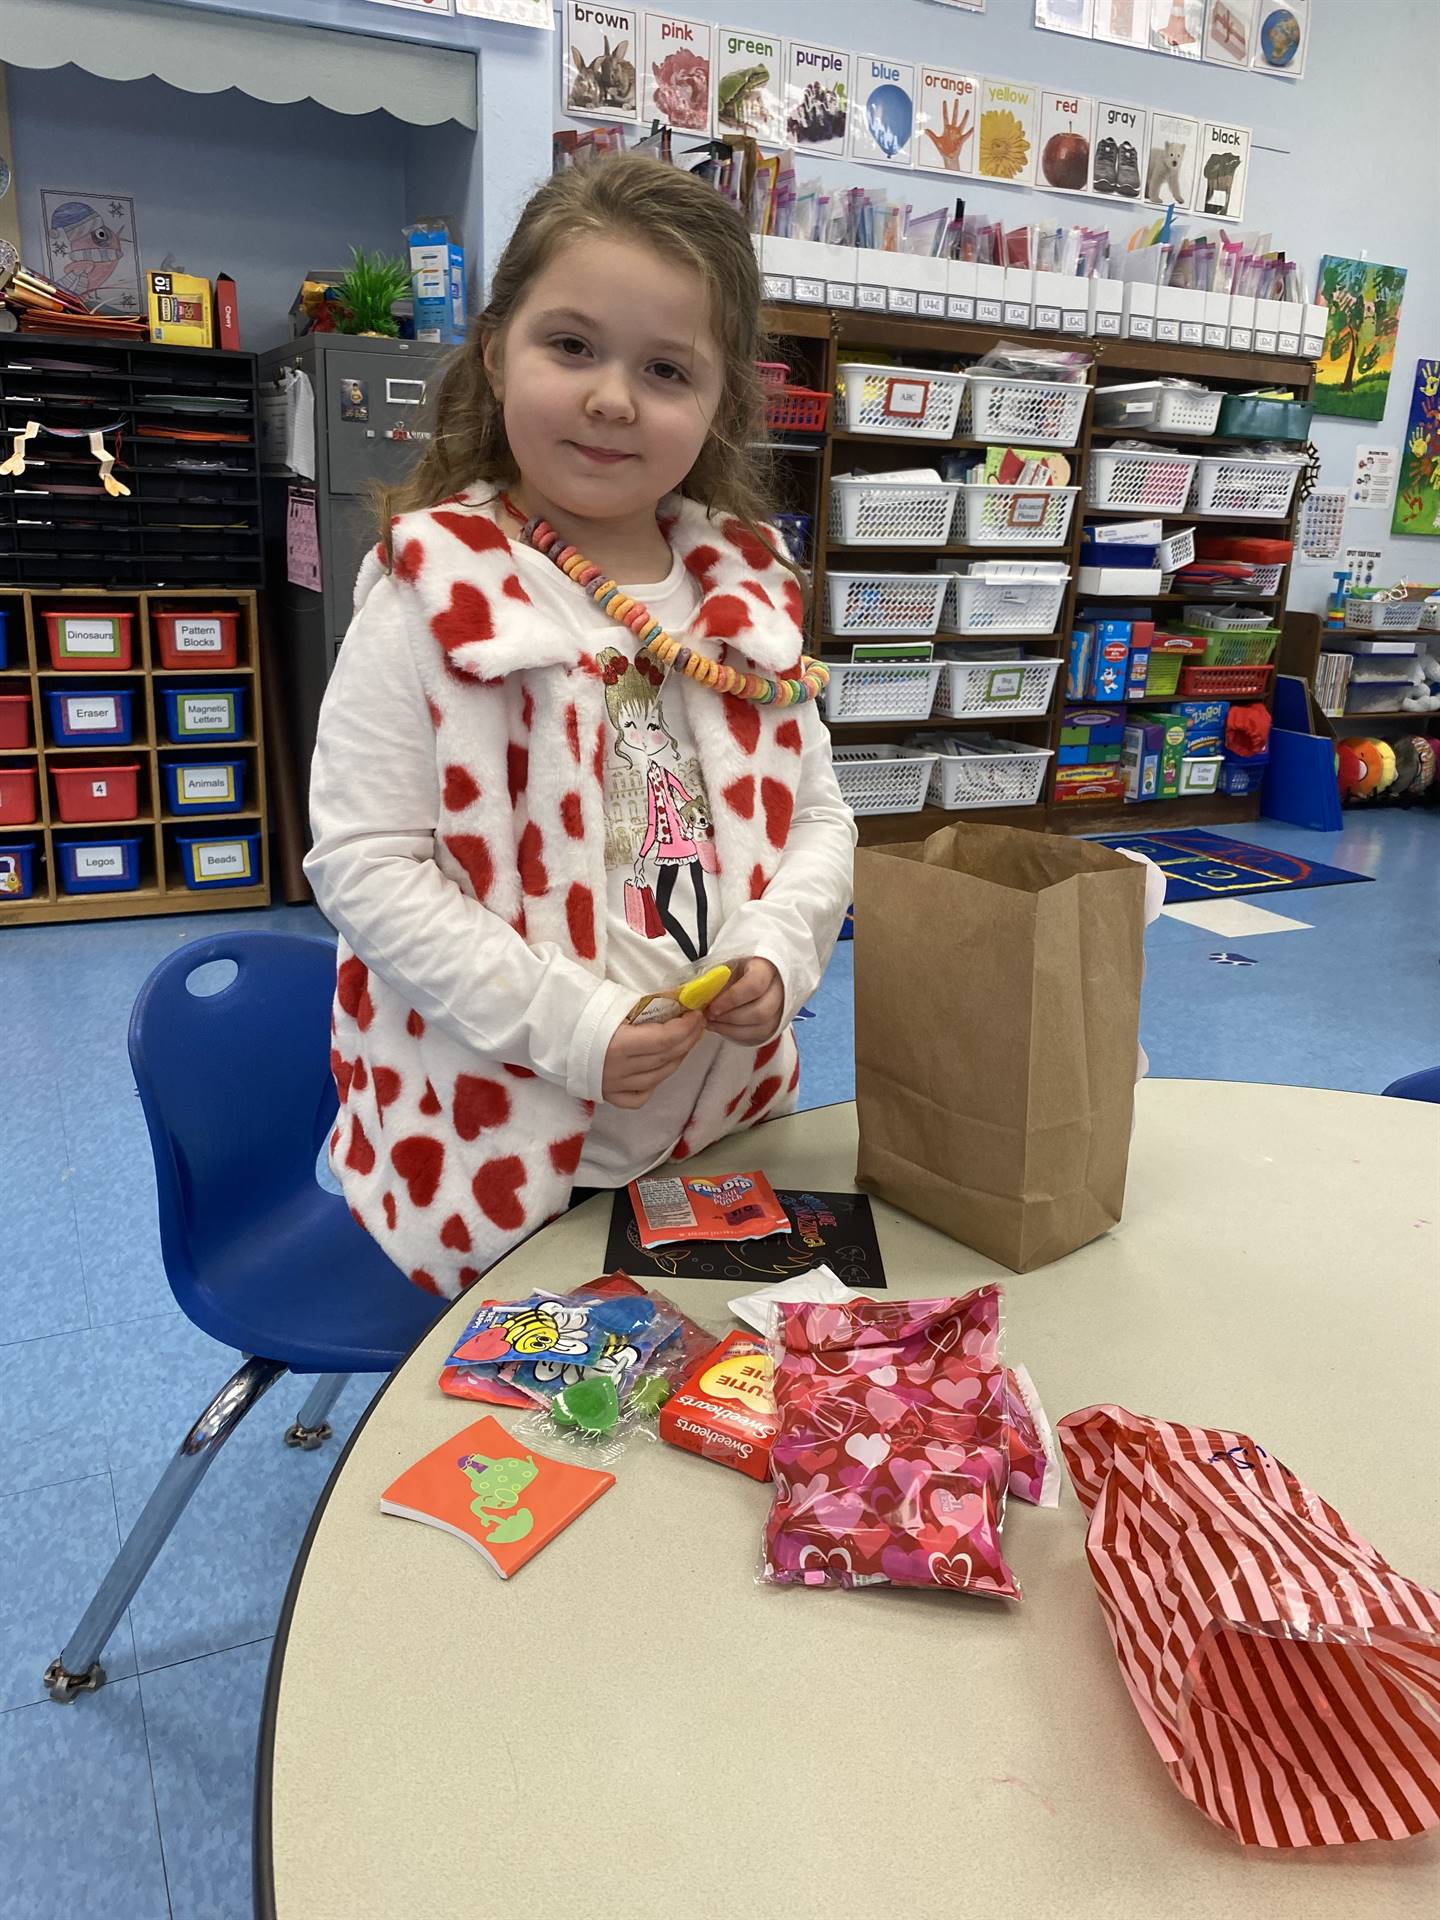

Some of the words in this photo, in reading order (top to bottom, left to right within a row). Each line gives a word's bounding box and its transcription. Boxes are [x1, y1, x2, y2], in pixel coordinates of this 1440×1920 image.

[574, 4, 629, 31] brown
[661, 22, 694, 41] pink
[728, 36, 773, 57] green
[796, 50, 843, 72] purple
[871, 62, 900, 81] blue
[925, 74, 973, 96] orange
[988, 86, 1029, 105] yellow
[1055, 99, 1079, 114] red
[1108, 109, 1136, 128] gray
[1212, 128, 1240, 146] black
[154, 276, 166, 292] 10
[901, 392, 916, 401] ABC
[67, 630, 113, 640] Dinosaurs
[181, 626, 216, 635] Pattern
[183, 638, 215, 647] Blocks
[76, 709, 109, 718] Eraser
[188, 705, 227, 715] Magnetic
[193, 715, 222, 724] Letters
[96, 784, 103, 794] 4
[188, 779, 225, 788] Animals
[86, 858, 115, 868] Legos
[207, 854, 237, 865] Beads
[693, 1183, 722, 1194] Fun
[722, 1178, 751, 1191] Dip
[716, 1374, 766, 1397] UTIE
[677, 1395, 776, 1439] Sweethearts
[676, 1418, 753, 1459] Sweethearts
